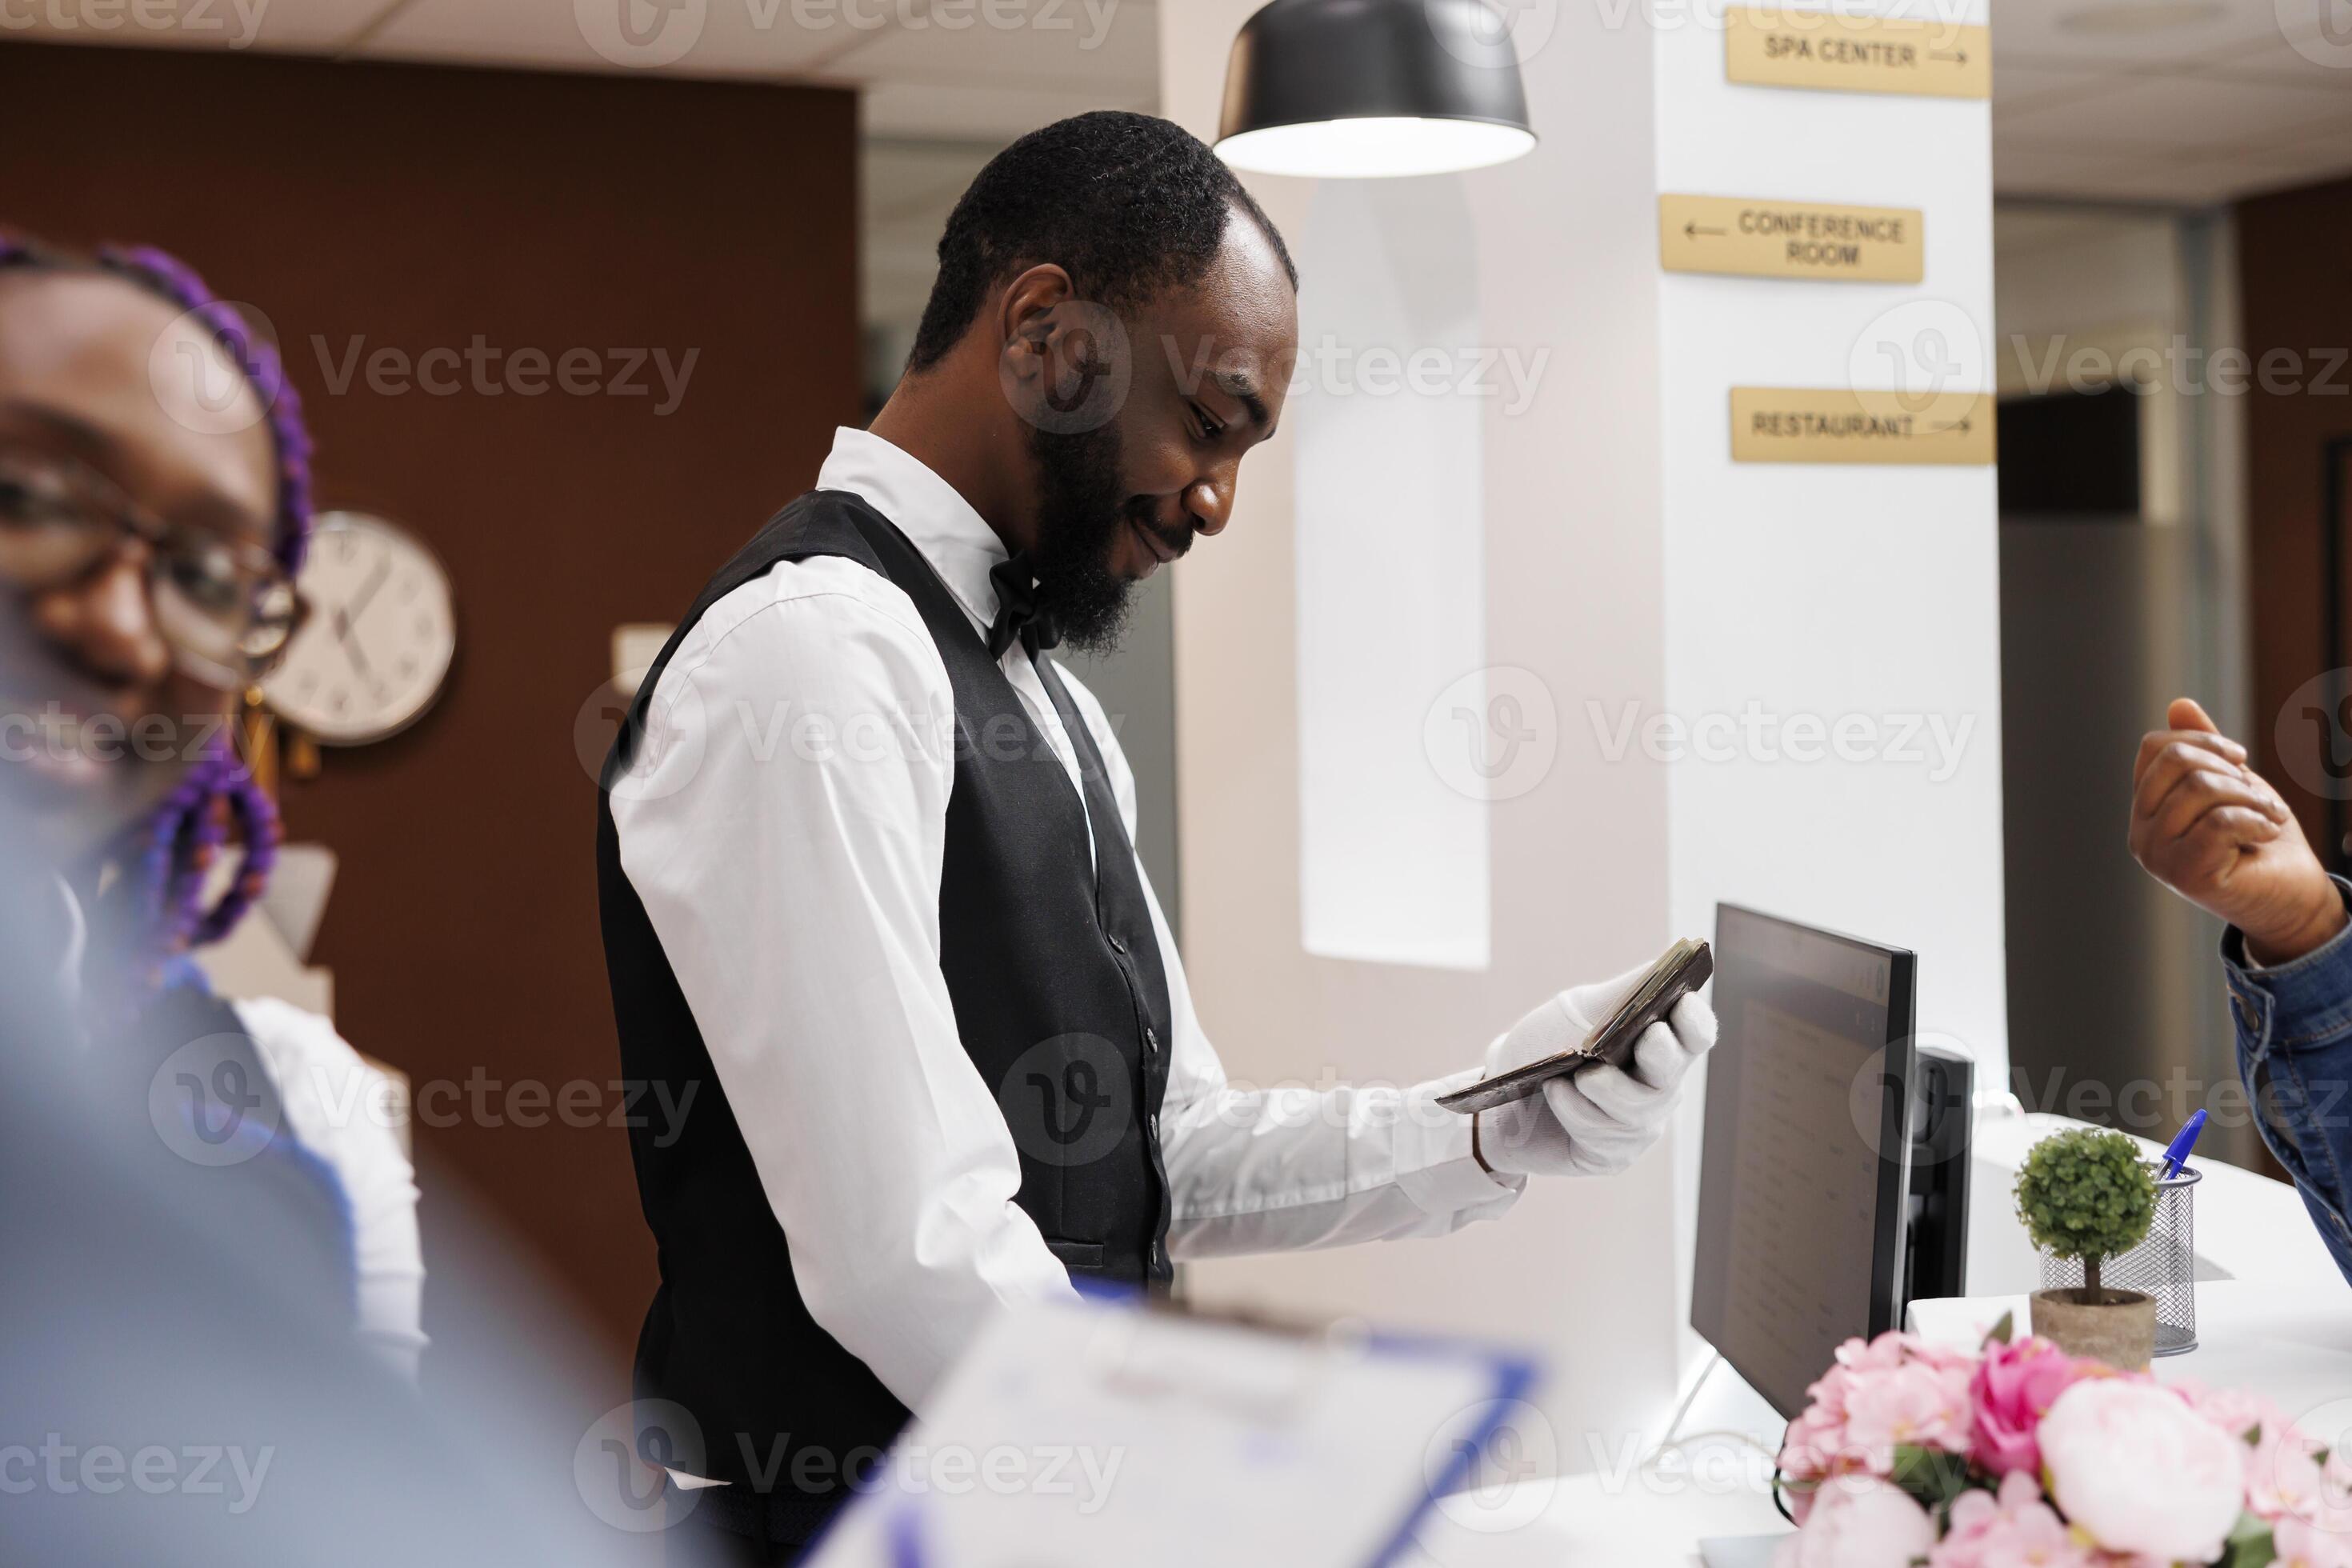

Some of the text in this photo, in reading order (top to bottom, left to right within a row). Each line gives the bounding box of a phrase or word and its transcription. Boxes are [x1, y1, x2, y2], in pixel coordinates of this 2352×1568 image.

[1765, 34, 1917, 68] SPA CENTER
[1738, 209, 1906, 243] CONFERENCE
[1786, 240, 1860, 267] ROOM
[1752, 411, 1914, 439] RESTAURANT
